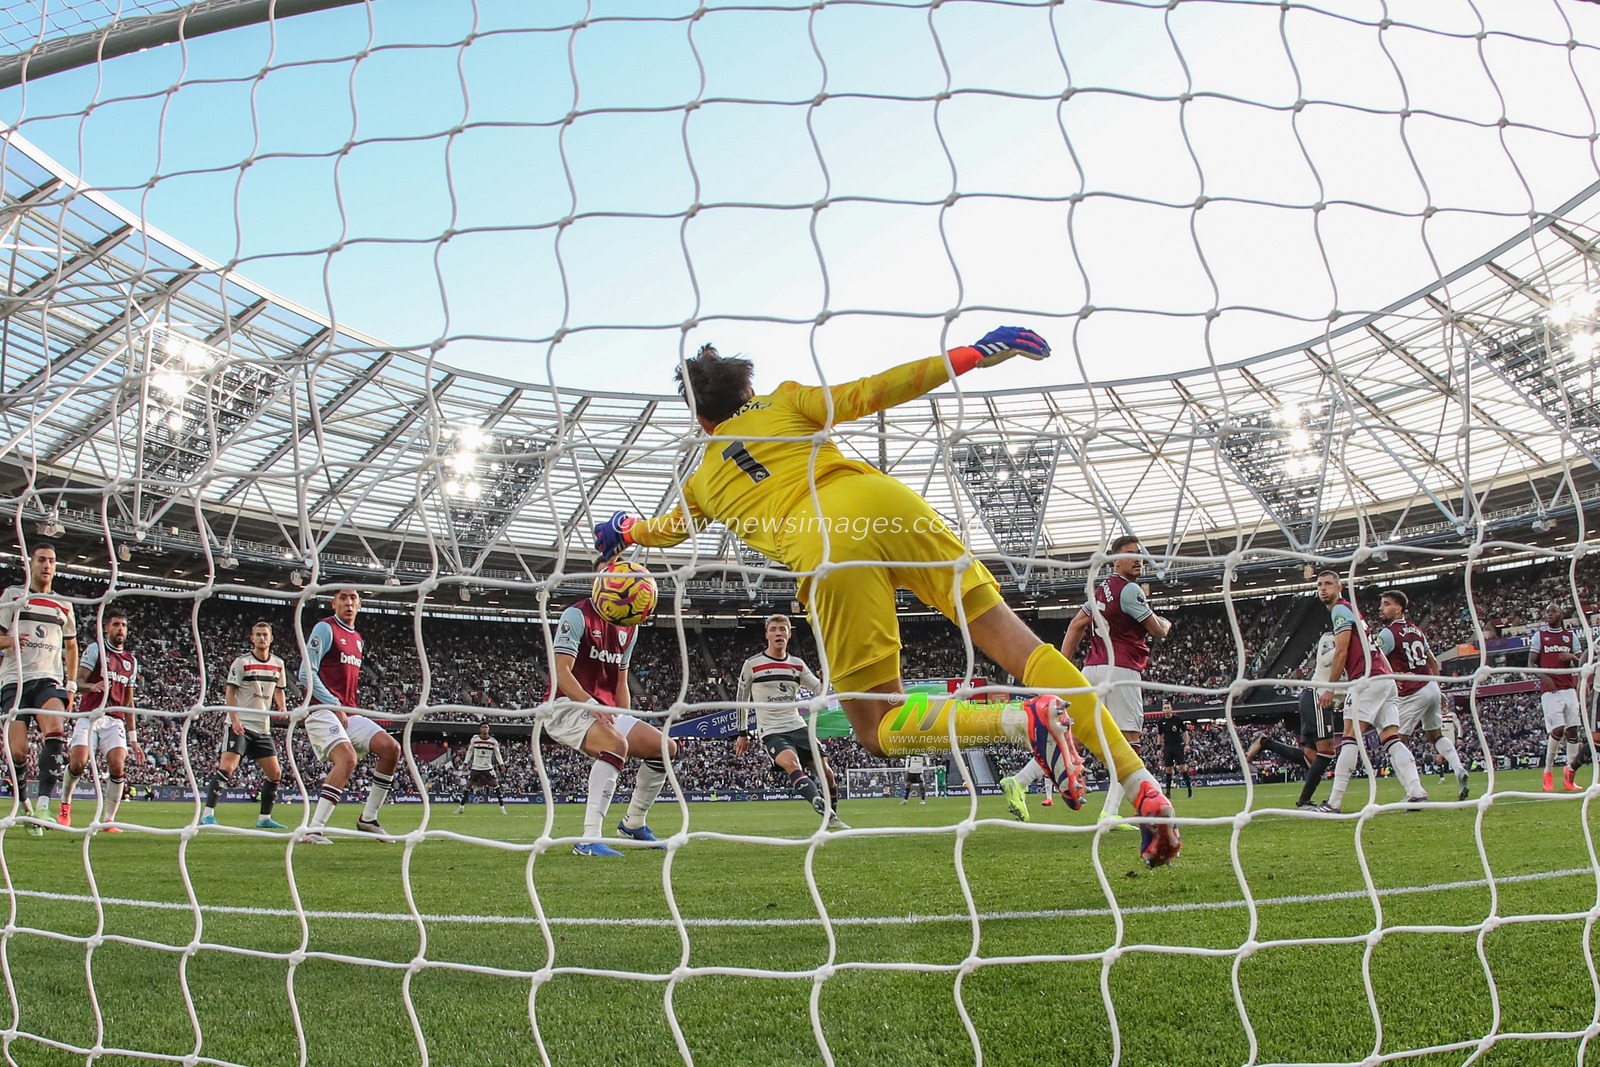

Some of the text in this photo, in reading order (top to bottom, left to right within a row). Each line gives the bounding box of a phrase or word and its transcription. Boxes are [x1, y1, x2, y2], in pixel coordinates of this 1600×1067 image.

[721, 439, 772, 484] 1
[1402, 640, 1427, 669] 10
[1544, 644, 1571, 653] betway
[712, 714, 728, 727] STAY
[720, 725, 728, 734] at
